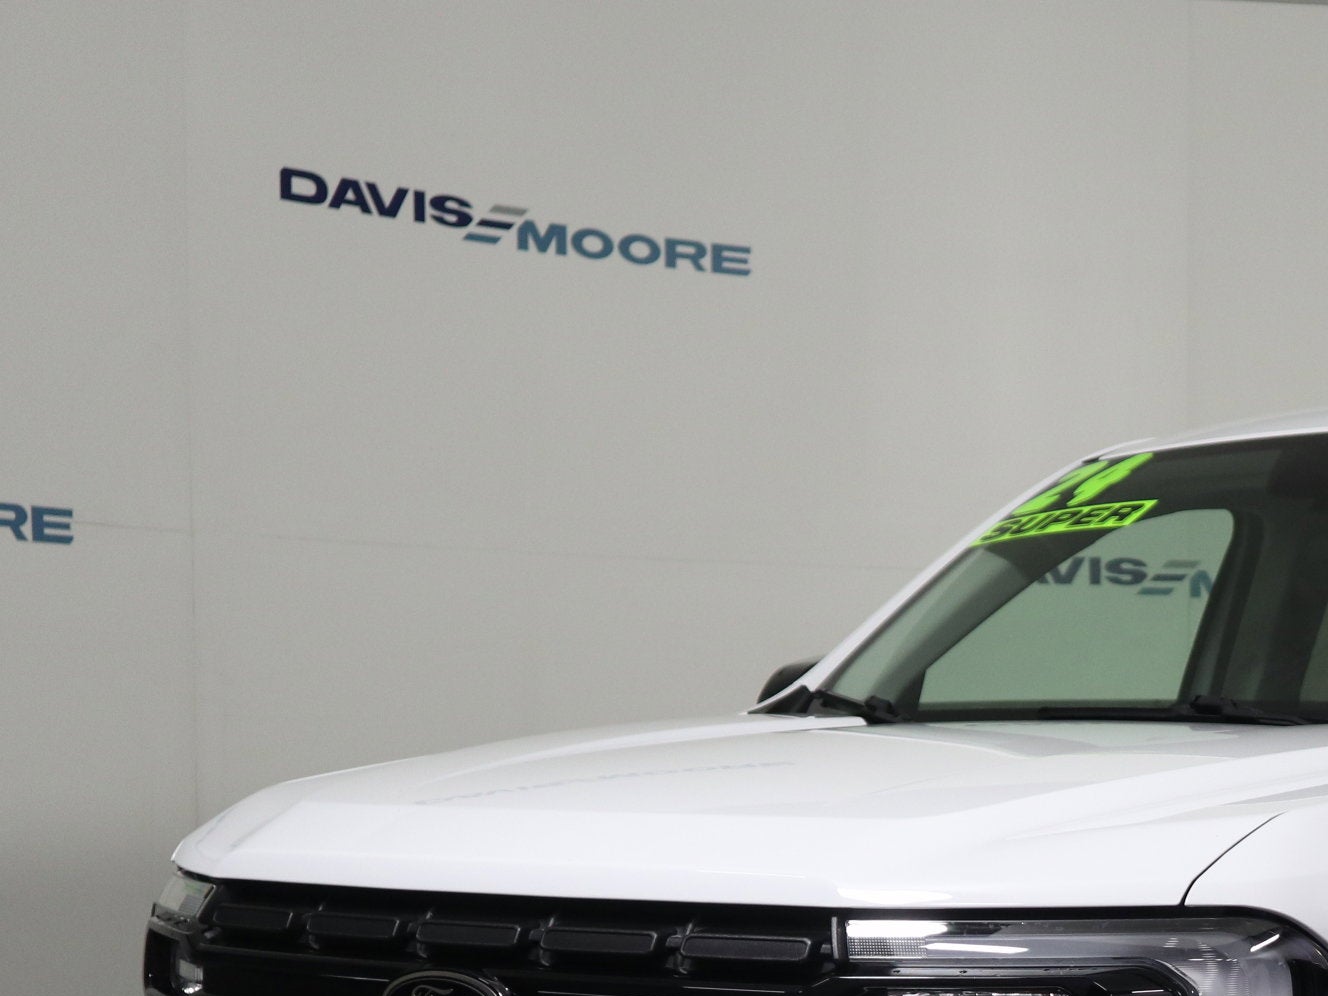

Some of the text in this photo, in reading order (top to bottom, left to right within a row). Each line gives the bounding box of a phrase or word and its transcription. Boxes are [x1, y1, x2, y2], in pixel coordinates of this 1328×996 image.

[280, 166, 751, 276] DAVIS MOORE
[980, 502, 1148, 542] SUPER
